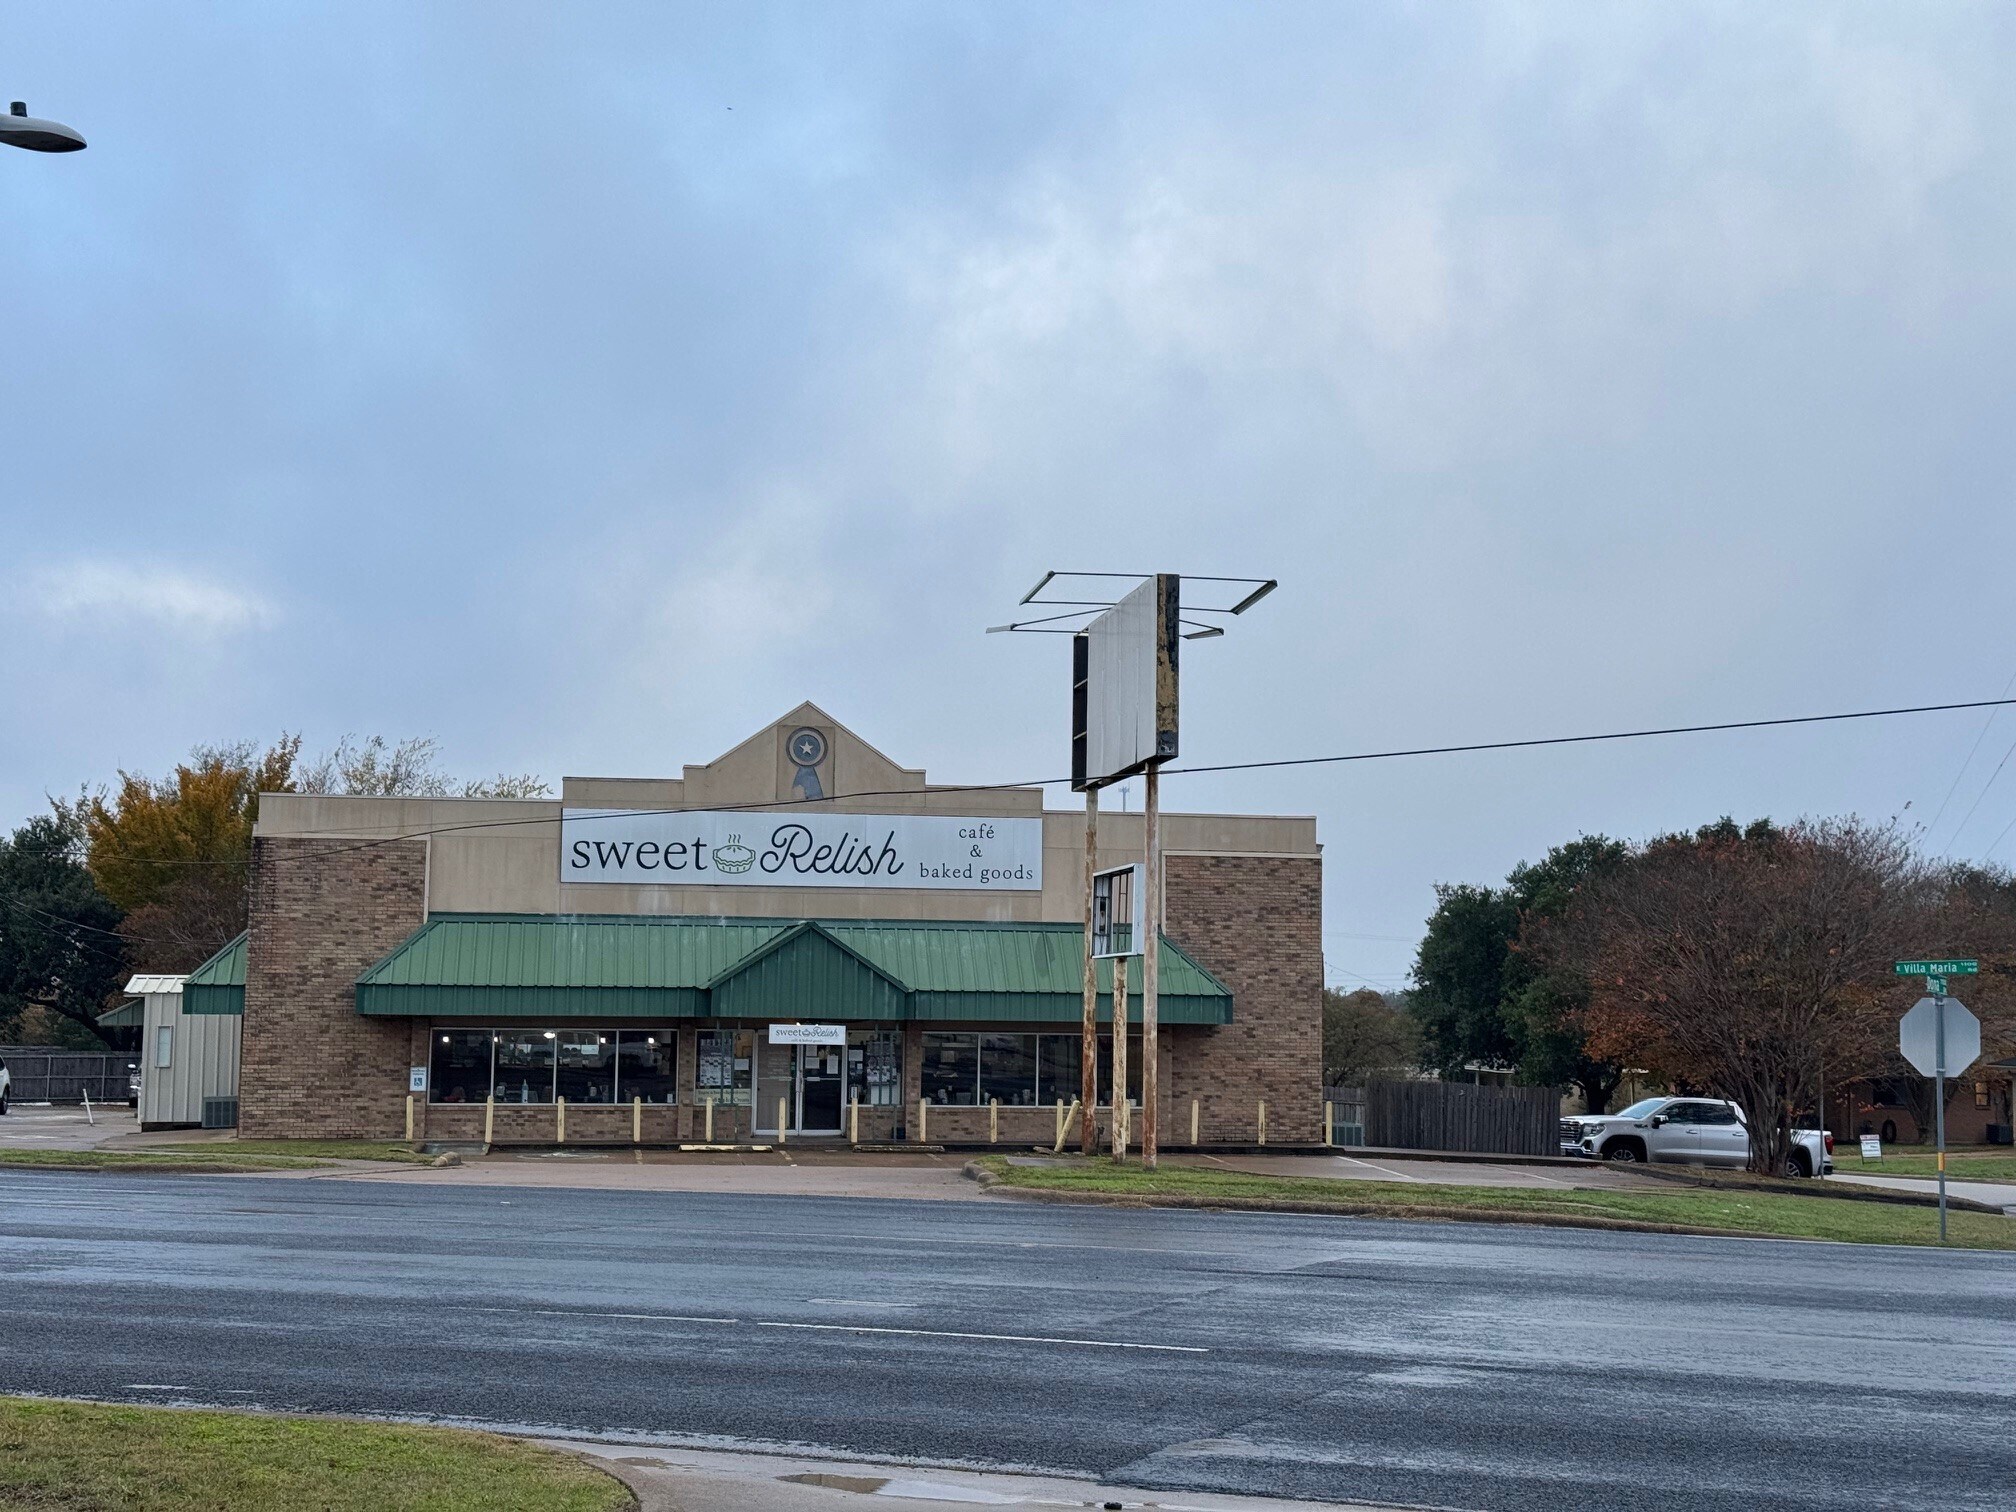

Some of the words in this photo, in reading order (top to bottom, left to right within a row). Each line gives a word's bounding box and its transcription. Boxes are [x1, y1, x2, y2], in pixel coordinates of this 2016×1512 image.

[958, 823, 995, 840] café
[571, 836, 708, 871] sweet
[759, 823, 904, 876] Relish
[969, 845, 983, 858] &
[919, 863, 973, 880] baked
[980, 864, 1034, 884] goods
[1904, 963, 1926, 974] Villa
[1930, 962, 1957, 973] Maria
[775, 1028, 802, 1037] sweet
[810, 1026, 839, 1037] Relish
